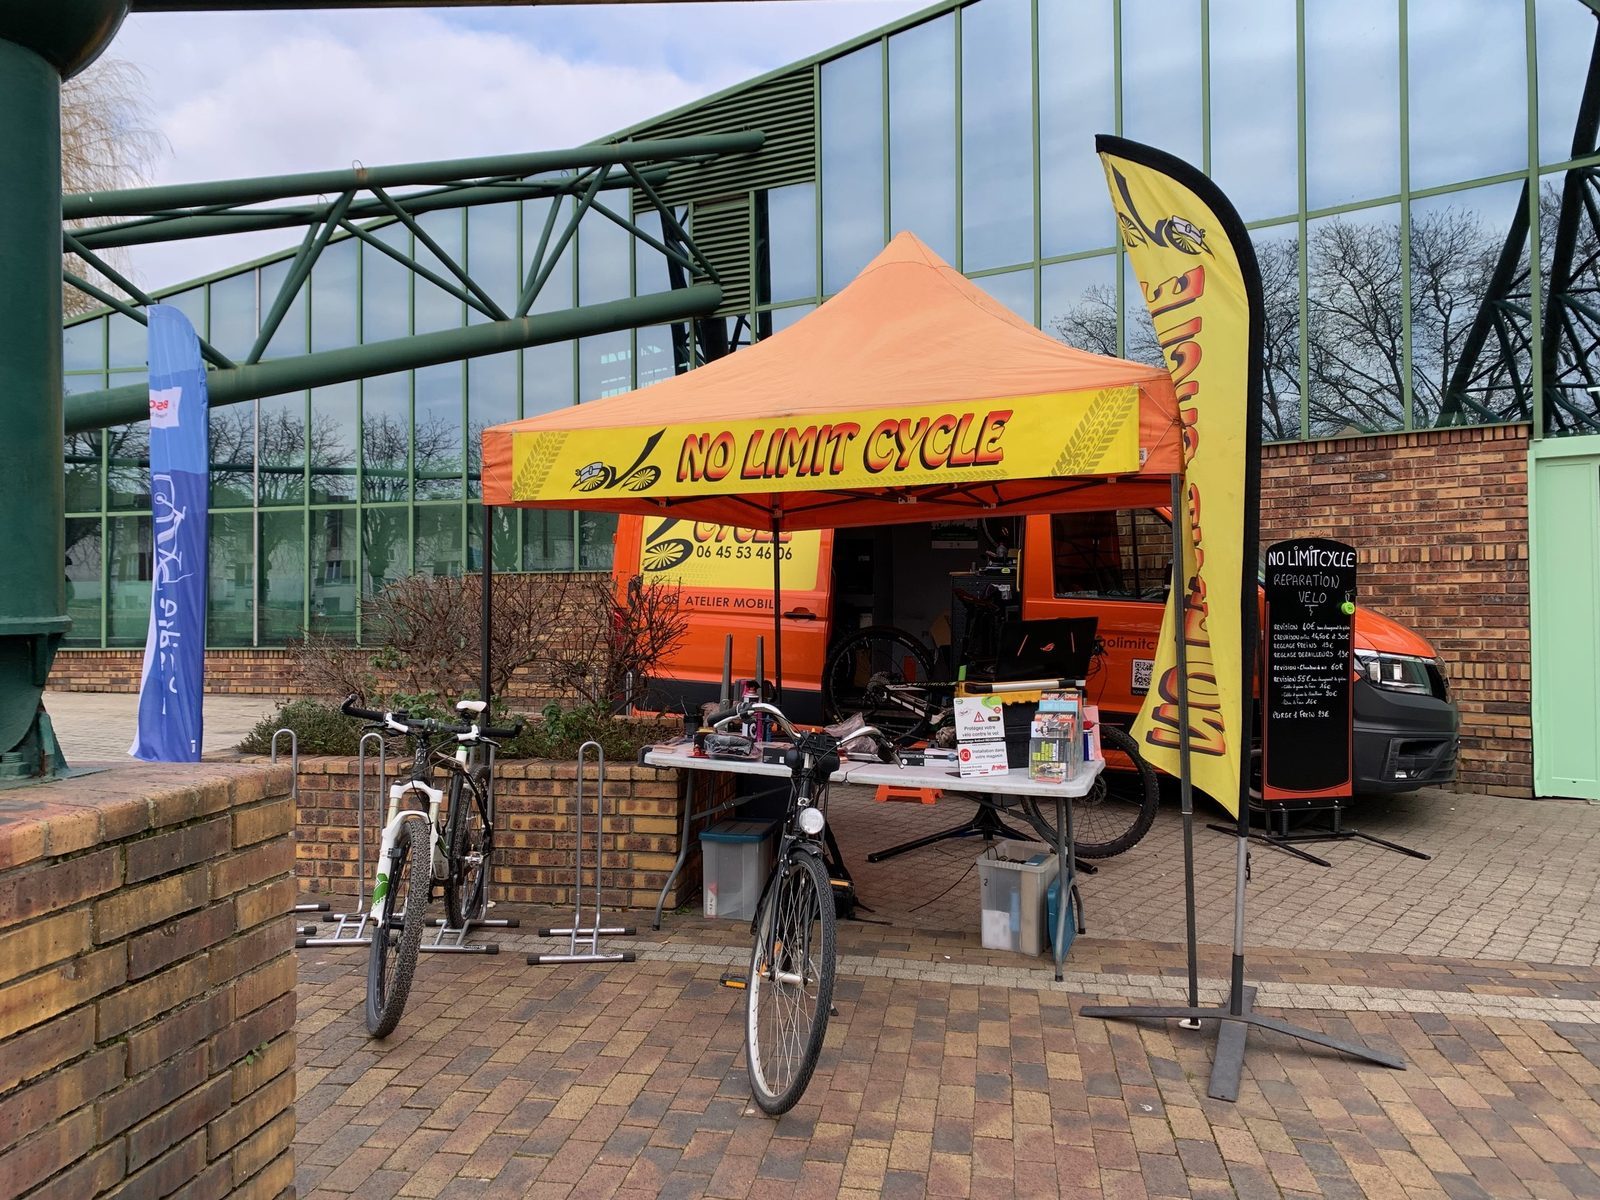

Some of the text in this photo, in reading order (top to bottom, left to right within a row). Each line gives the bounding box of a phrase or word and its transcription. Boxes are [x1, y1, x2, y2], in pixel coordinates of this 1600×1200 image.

[676, 410, 1013, 482] NO LIMIT CYCLE
[696, 545, 711, 558] 06
[716, 546, 731, 559] 45
[736, 547, 752, 559] 53
[756, 548, 772, 559] 46
[1268, 551, 1285, 566] NO
[685, 596, 730, 607] ATELIER
[733, 598, 774, 609] MOBIL
